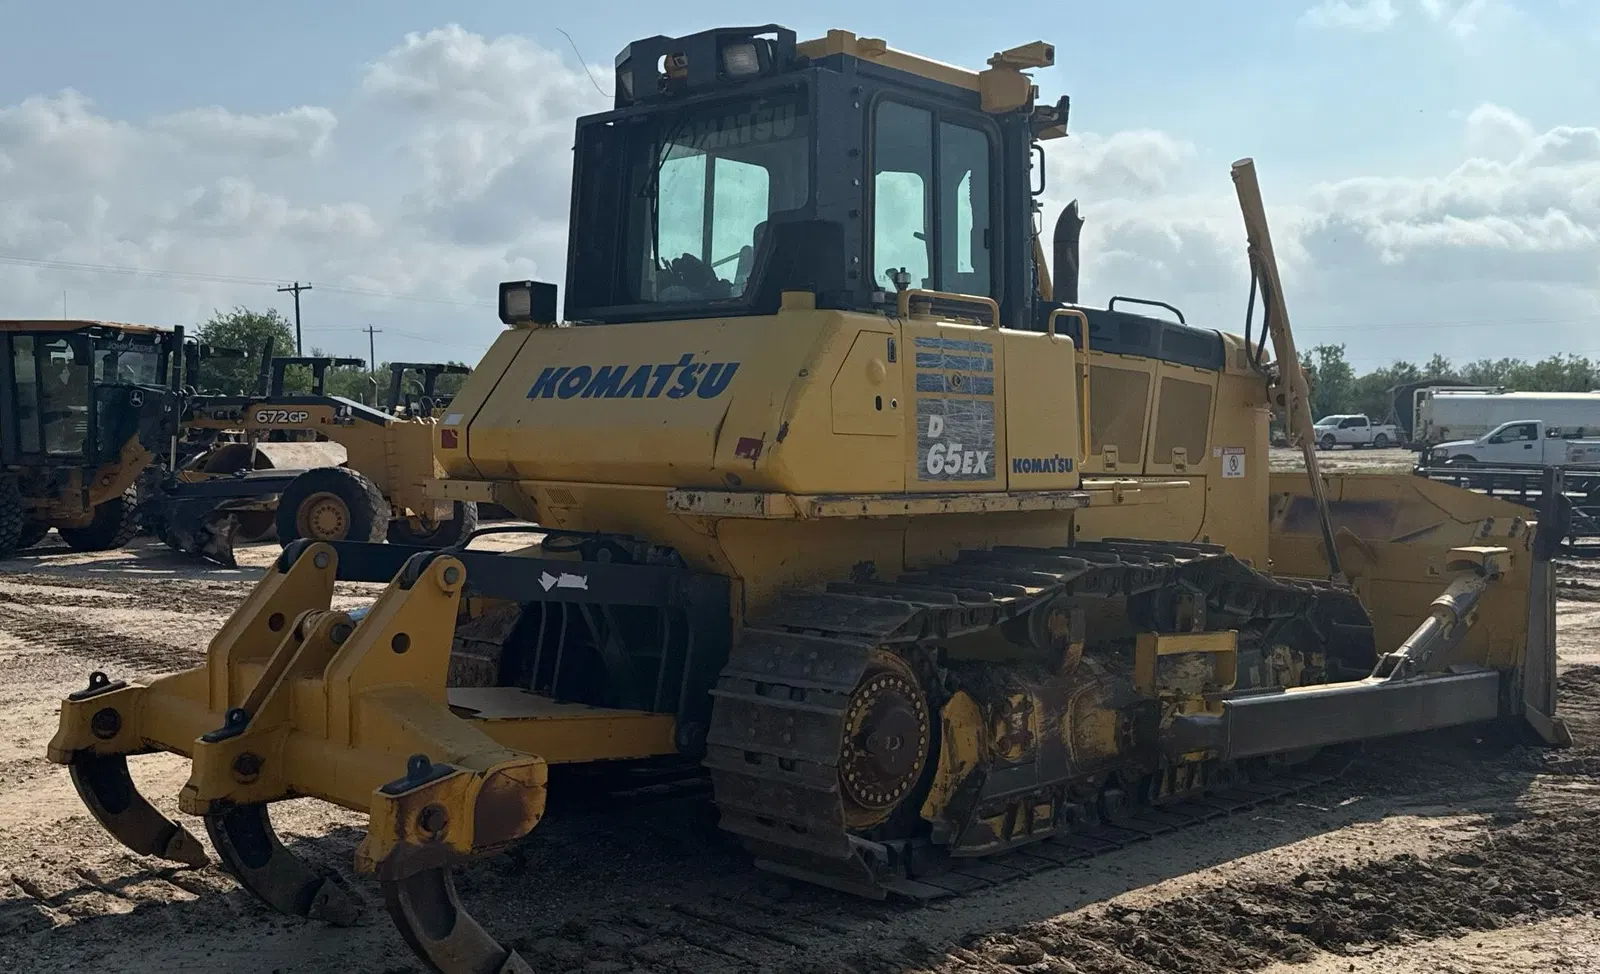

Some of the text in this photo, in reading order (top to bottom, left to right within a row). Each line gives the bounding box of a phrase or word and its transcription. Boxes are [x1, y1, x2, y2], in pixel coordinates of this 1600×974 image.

[526, 353, 741, 400] KOMATSU
[256, 409, 310, 424] 672GP
[927, 414, 944, 438] D
[928, 444, 988, 475] 65EX
[1013, 454, 1073, 473] KOMATSU
